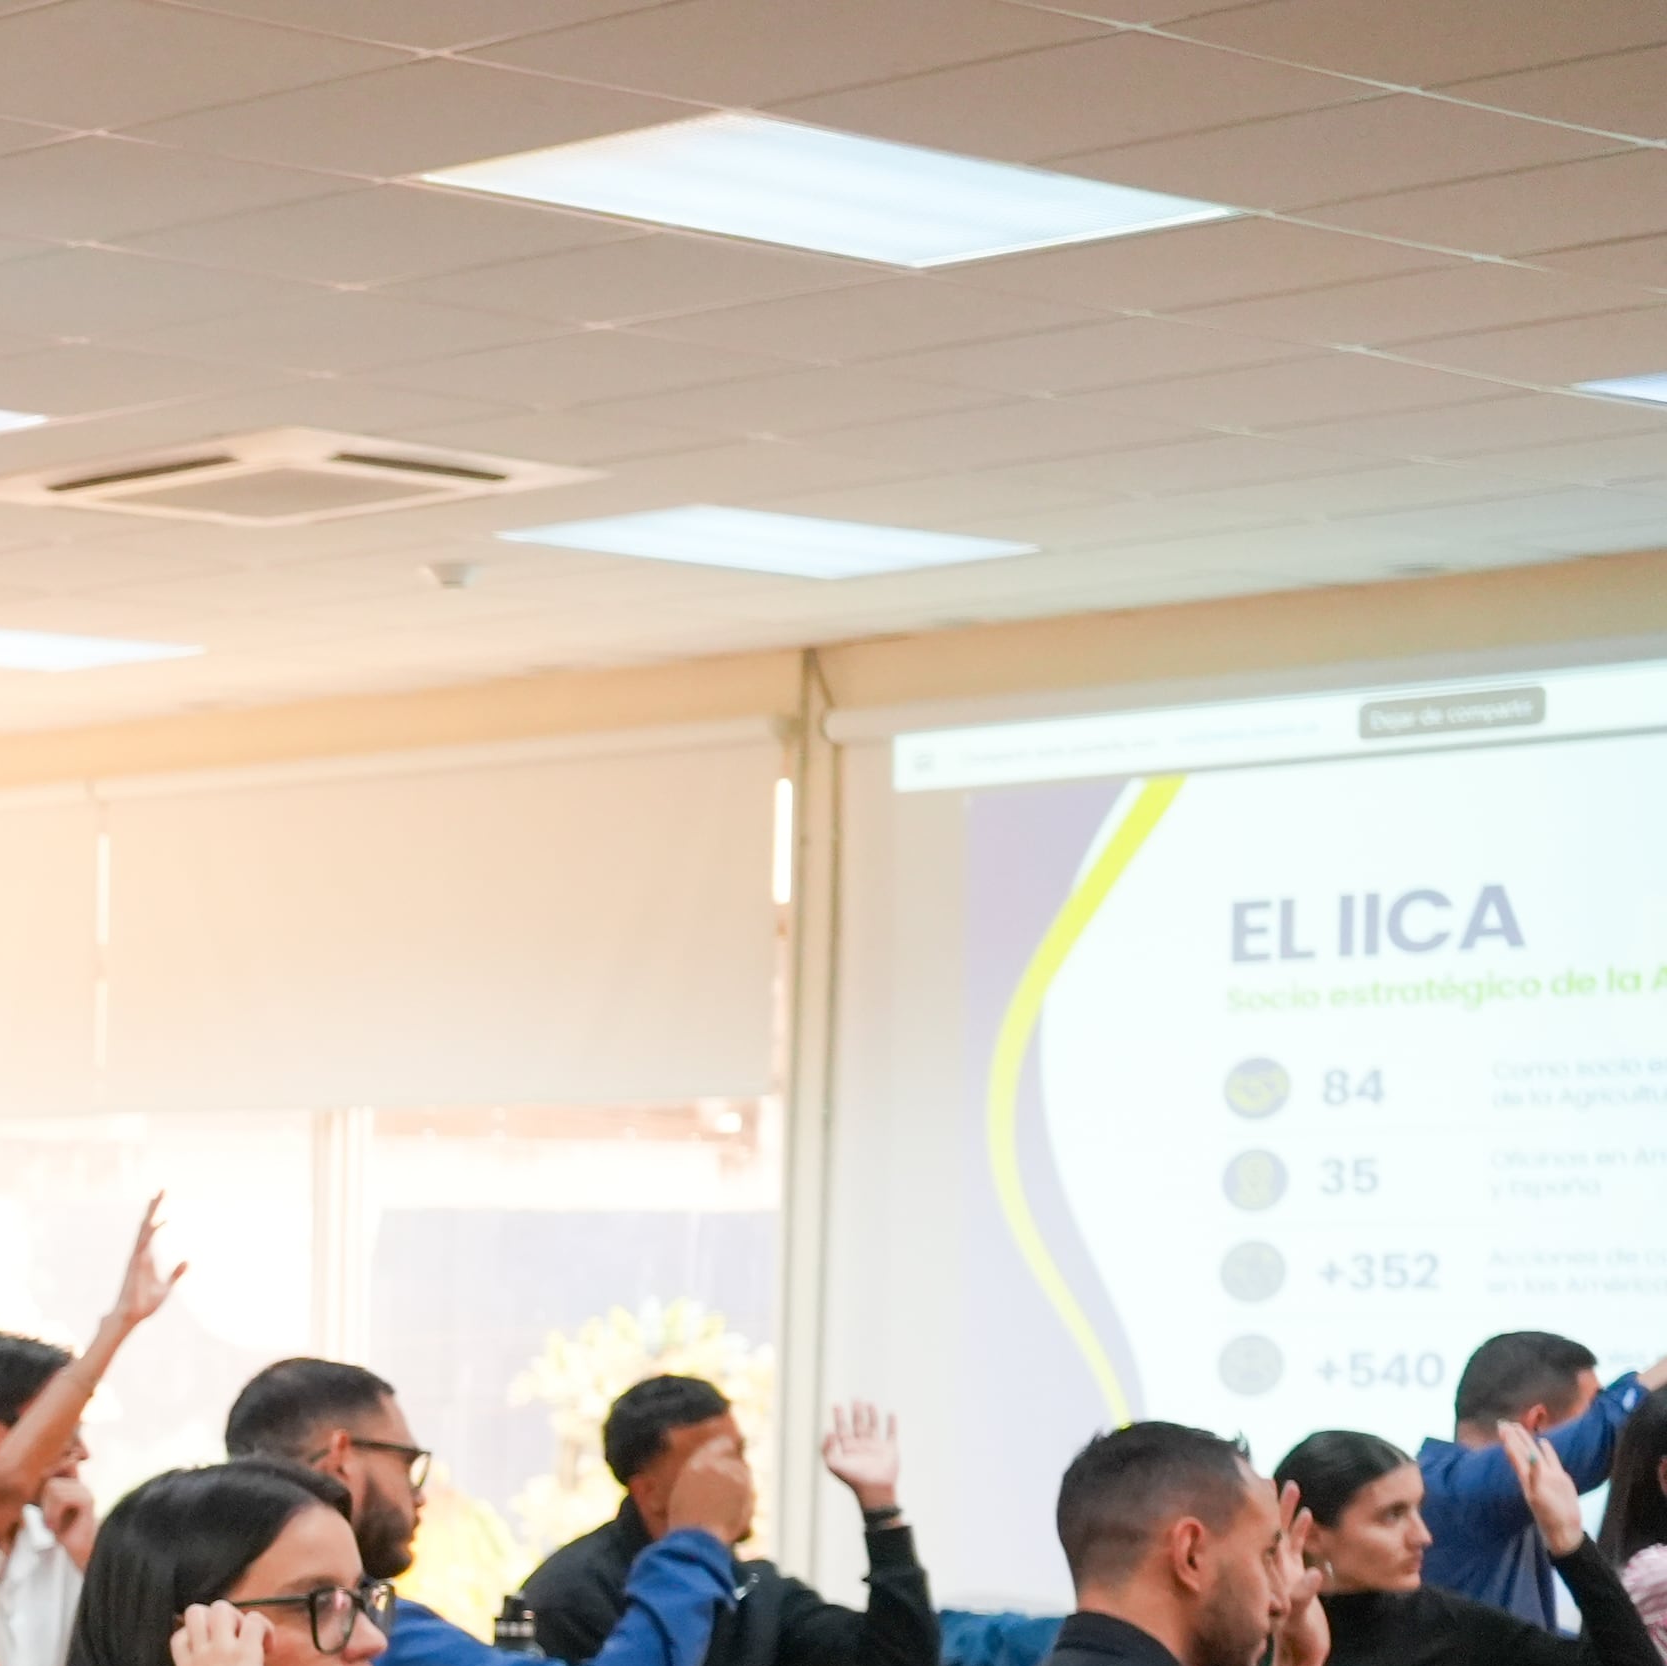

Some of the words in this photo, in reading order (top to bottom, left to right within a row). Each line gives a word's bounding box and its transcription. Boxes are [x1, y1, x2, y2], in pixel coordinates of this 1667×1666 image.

[1232, 898, 1316, 962] EL
[1338, 883, 1525, 957] IICA
[1227, 979, 1321, 1014] Socio
[1329, 968, 1541, 1011] estratégico
[1550, 962, 1597, 999] de
[1607, 961, 1643, 995] la
[1322, 1068, 1385, 1106] 84
[1320, 1157, 1380, 1195] 35
[1319, 1253, 1441, 1290] +352
[1316, 1351, 1445, 1388] +540
